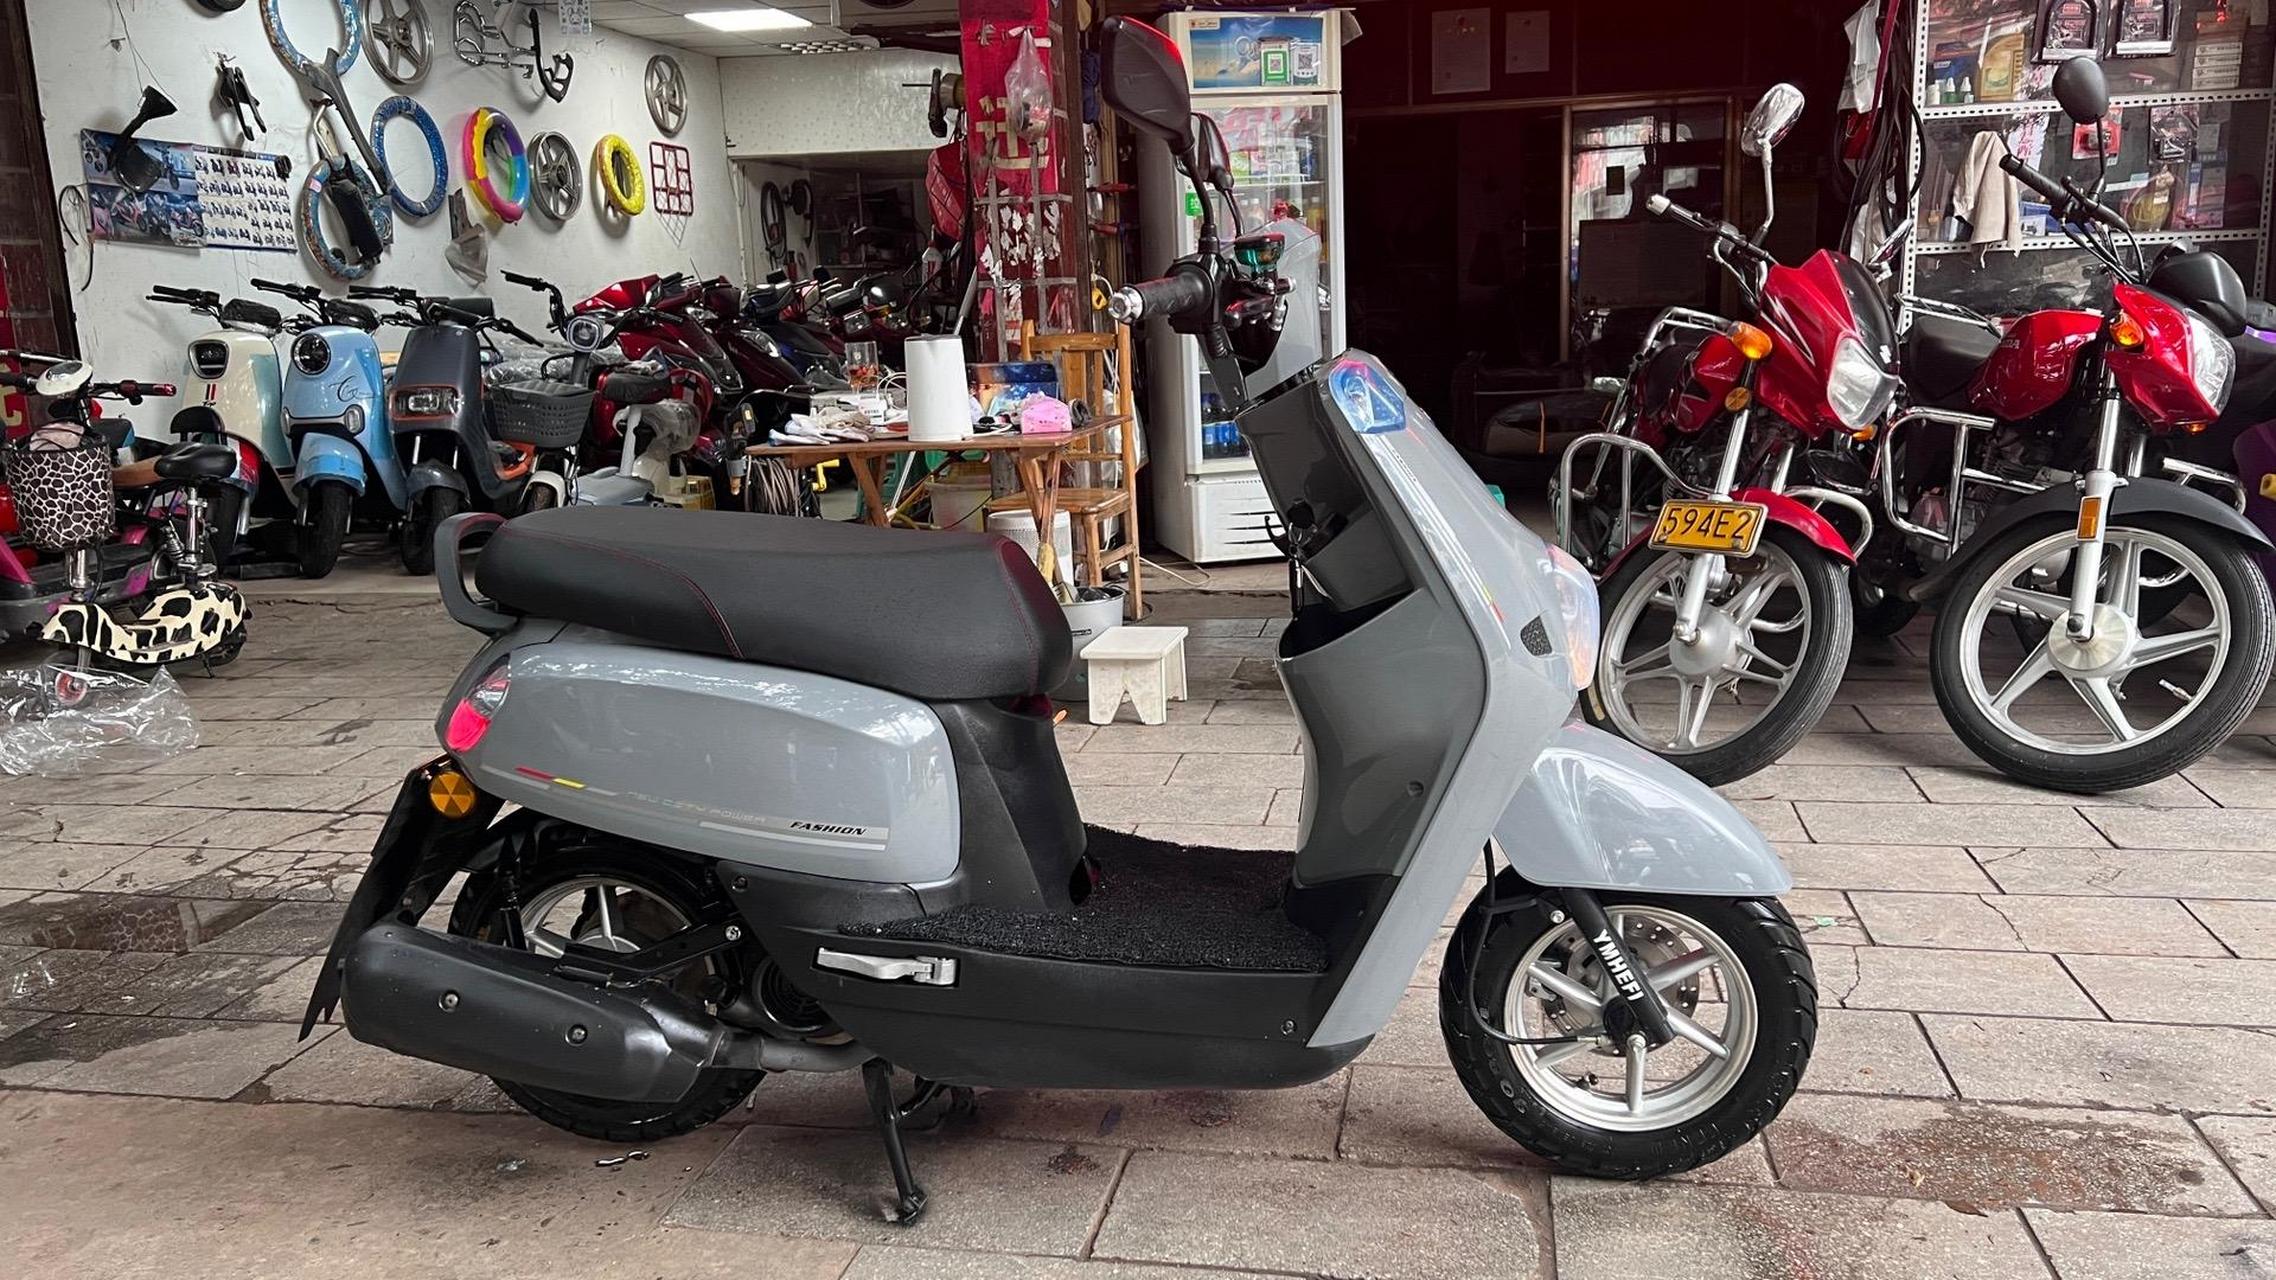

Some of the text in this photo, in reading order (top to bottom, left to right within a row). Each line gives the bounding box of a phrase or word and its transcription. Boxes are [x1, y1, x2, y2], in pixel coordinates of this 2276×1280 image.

[1662, 508, 1752, 539] 594E2
[790, 821, 867, 836] FASHION
[1592, 928, 1645, 1001] YMHEFI
